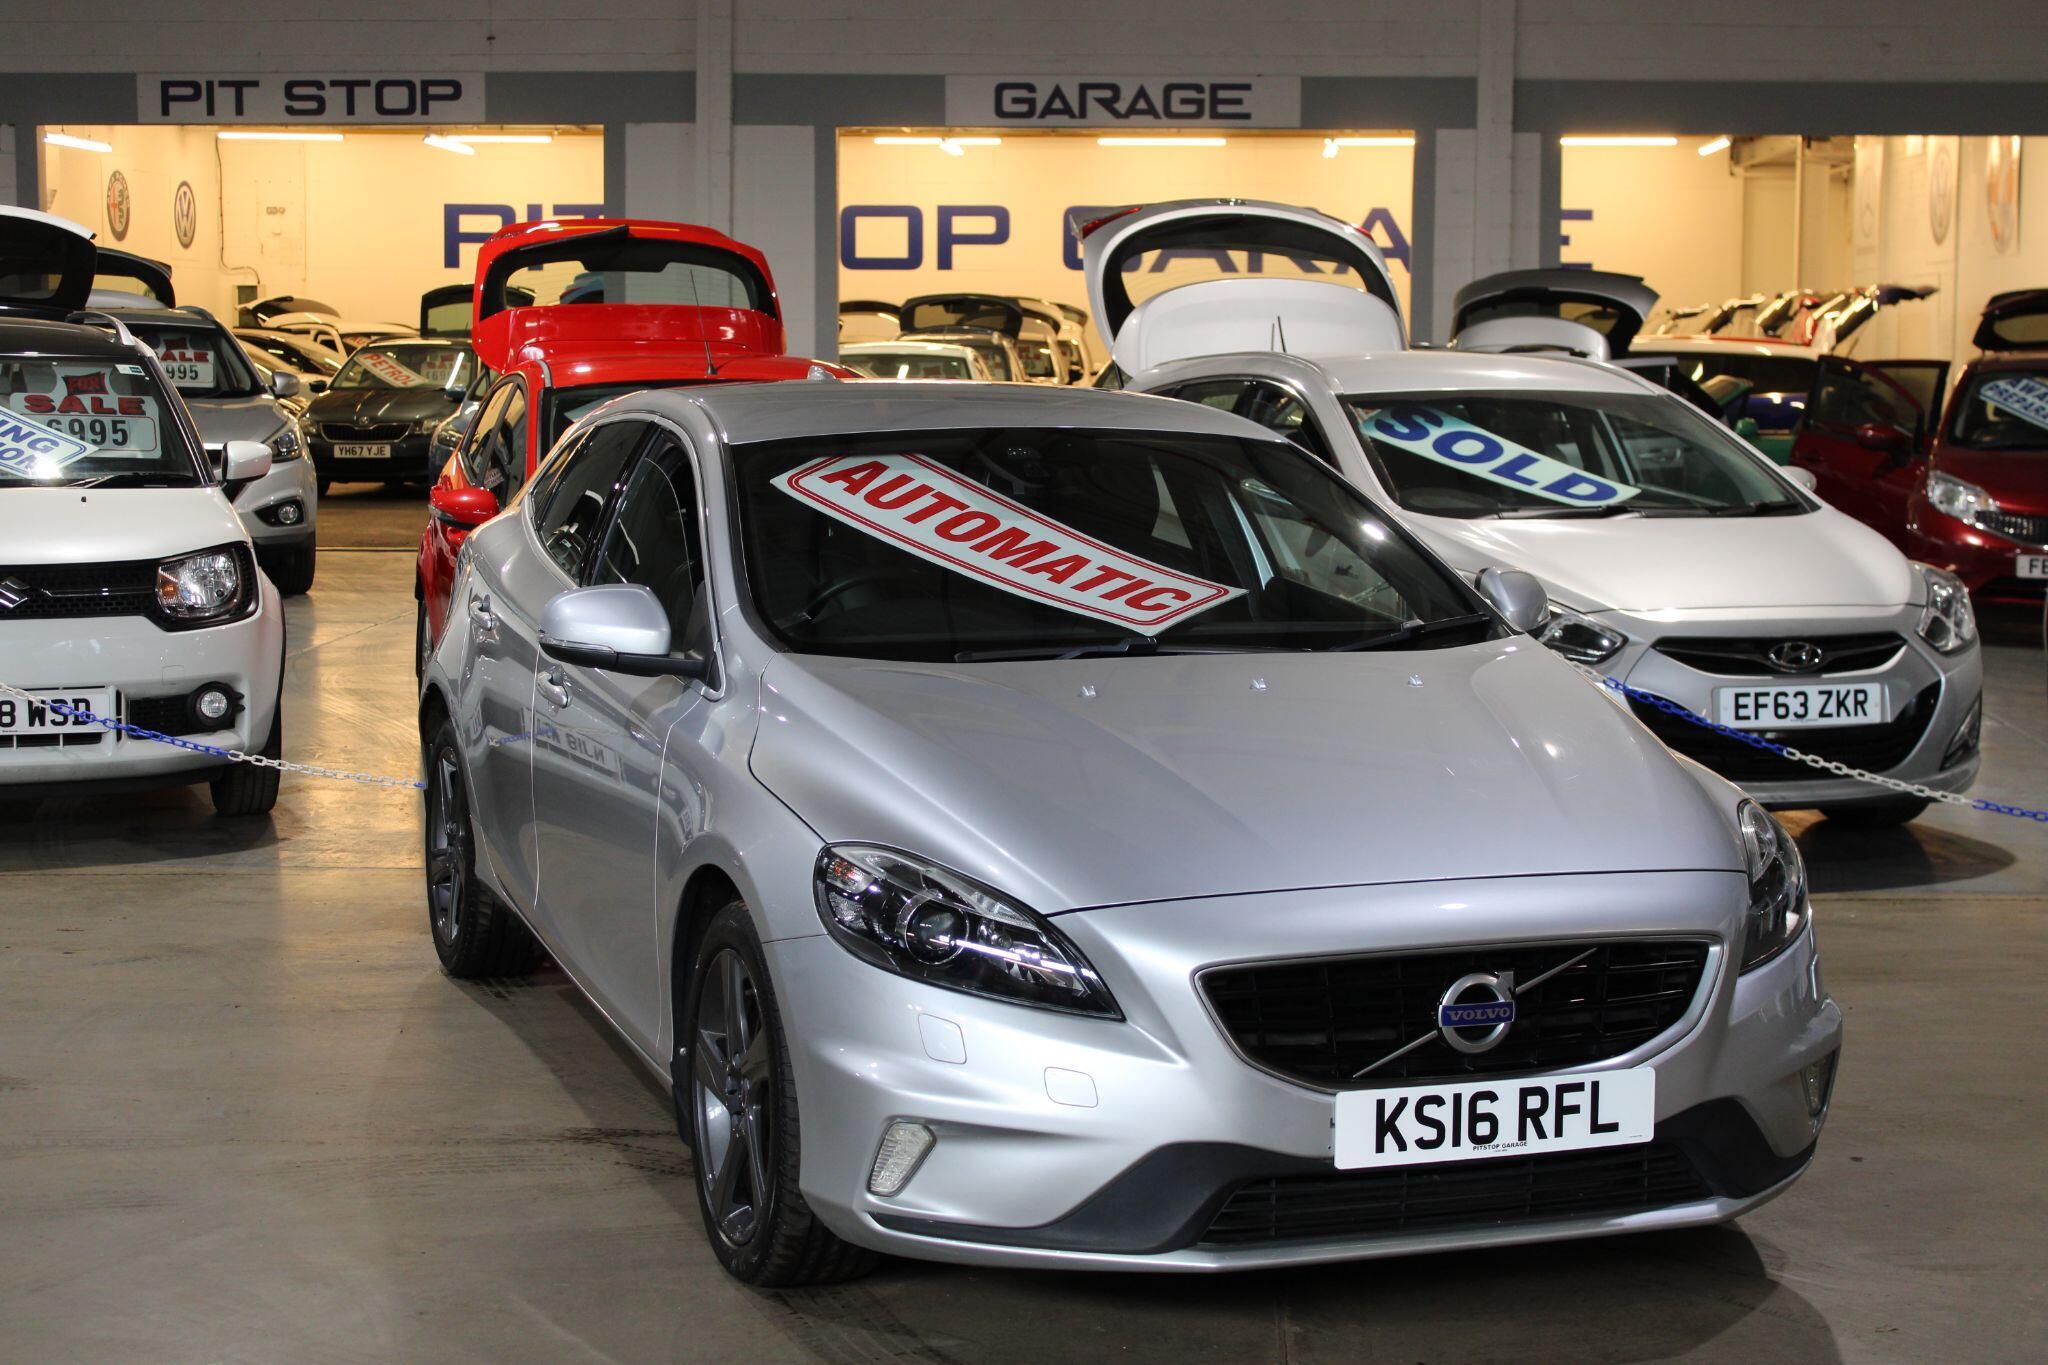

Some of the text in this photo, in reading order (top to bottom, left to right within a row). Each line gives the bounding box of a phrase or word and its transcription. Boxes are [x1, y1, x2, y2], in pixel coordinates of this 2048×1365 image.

[160, 79, 462, 117] PIT STOP
[995, 82, 1252, 120] GARAGE
[840, 205, 1010, 270] OP
[158, 351, 209, 362] ALE
[166, 364, 199, 380] 995
[364, 353, 416, 386] PETROL
[24, 395, 147, 415] SALE
[339, 446, 386, 457] YH67 YJE
[1374, 407, 1618, 502] SOLD
[819, 460, 1192, 612] AUTOMATIC
[27, 697, 91, 728] WSD
[1734, 689, 1868, 721] EF63 ZKR
[1446, 1006, 1510, 1021] VOLVO
[1375, 1080, 1620, 1154] KS16 RFL
[1473, 1141, 1527, 1151] PITSTOP GARAGE
